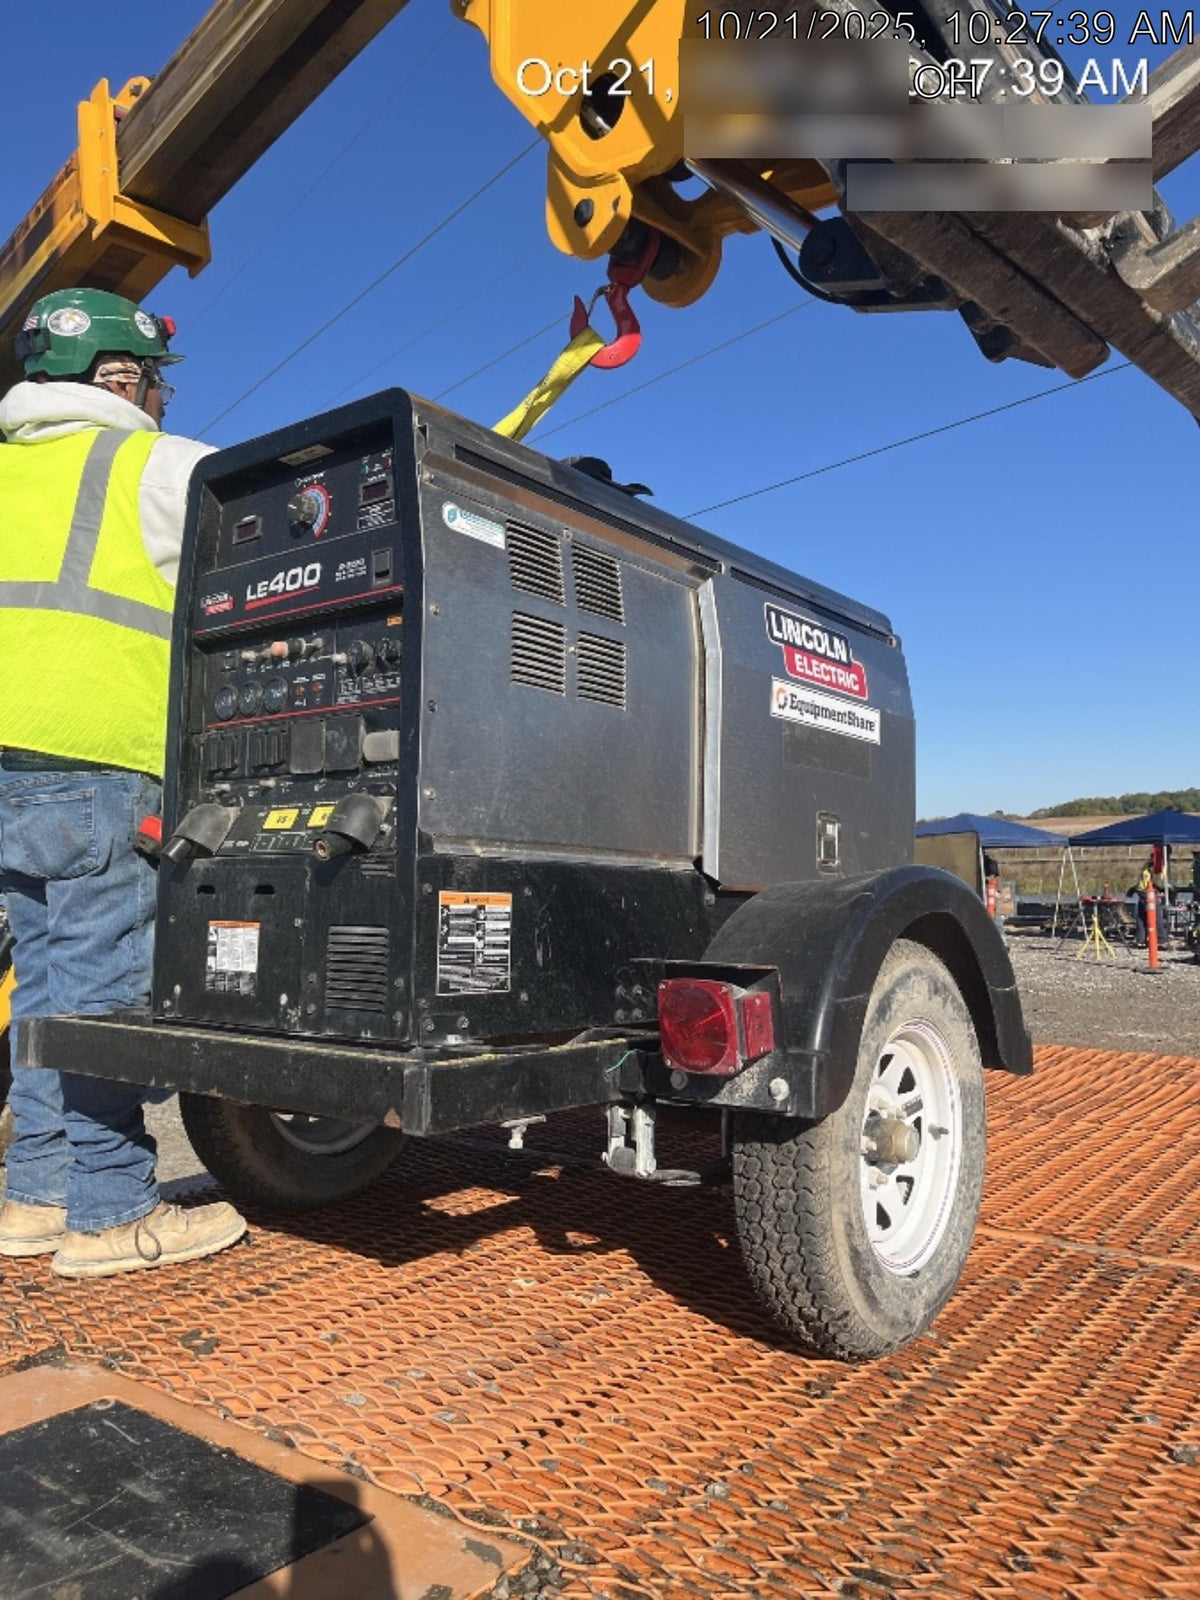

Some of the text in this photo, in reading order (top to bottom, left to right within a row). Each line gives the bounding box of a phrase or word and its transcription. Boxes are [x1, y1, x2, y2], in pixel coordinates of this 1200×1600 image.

[246, 562, 322, 602] LE400
[769, 610, 849, 664] LINCOLN
[794, 653, 860, 691] ELECTRIC
[789, 693, 876, 732] EquipmentShare
